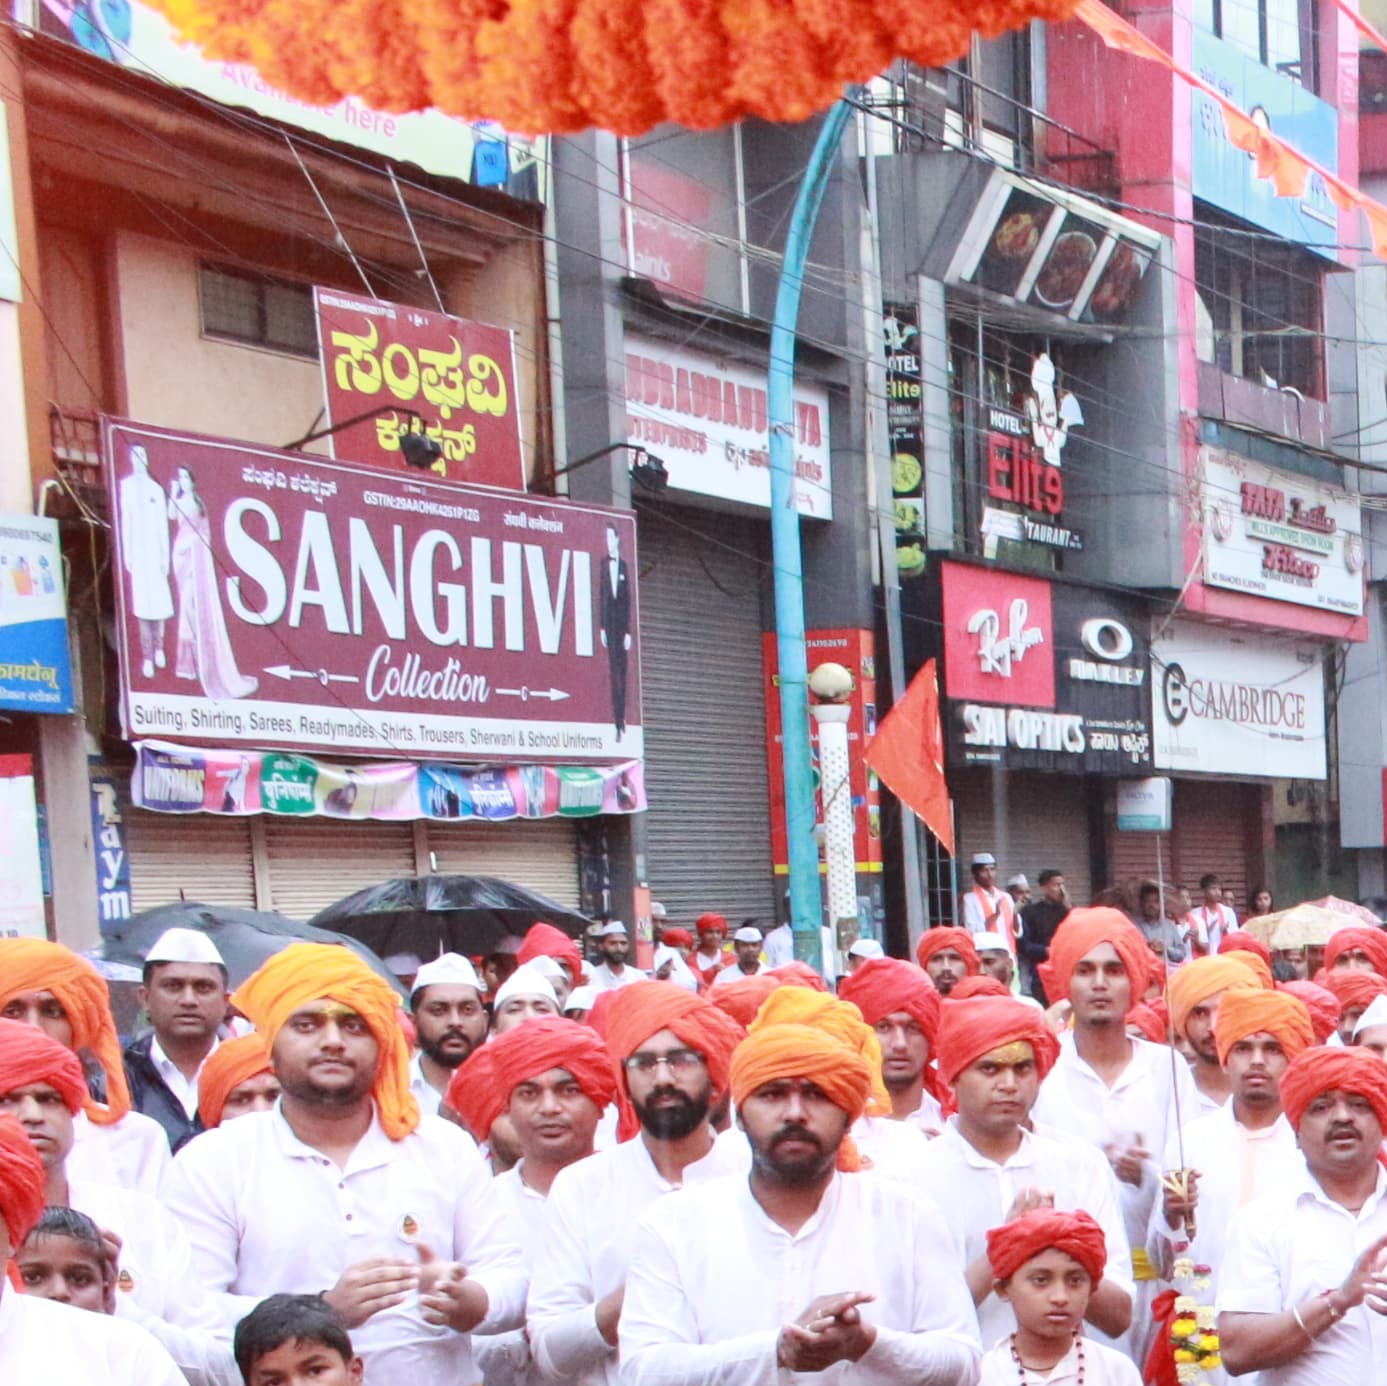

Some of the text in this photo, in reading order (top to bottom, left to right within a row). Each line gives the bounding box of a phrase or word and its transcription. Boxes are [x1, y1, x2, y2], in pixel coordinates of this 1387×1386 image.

[345, 96, 397, 138] here
[888, 355, 920, 372] OTEL
[990, 411, 1022, 435] HOTEL
[989, 431, 1066, 516] Elite
[224, 497, 593, 657] SANGHVI
[365, 644, 491, 704] Collection
[1069, 658, 1145, 687] OAKLEY
[135, 704, 187, 731] Suiting,
[191, 708, 245, 734] Shirting,
[250, 711, 296, 735] Sarees,
[300, 716, 377, 739] Readymades,
[380, 722, 416, 742] Shirts,
[470, 728, 516, 746] Sherwani
[519, 731, 525, 745] &
[528, 731, 560, 748] School
[562, 732, 603, 750] Uniforms
[964, 703, 1086, 754] SAI OPTICS
[1189, 679, 1306, 730] CAMBRIDGE
